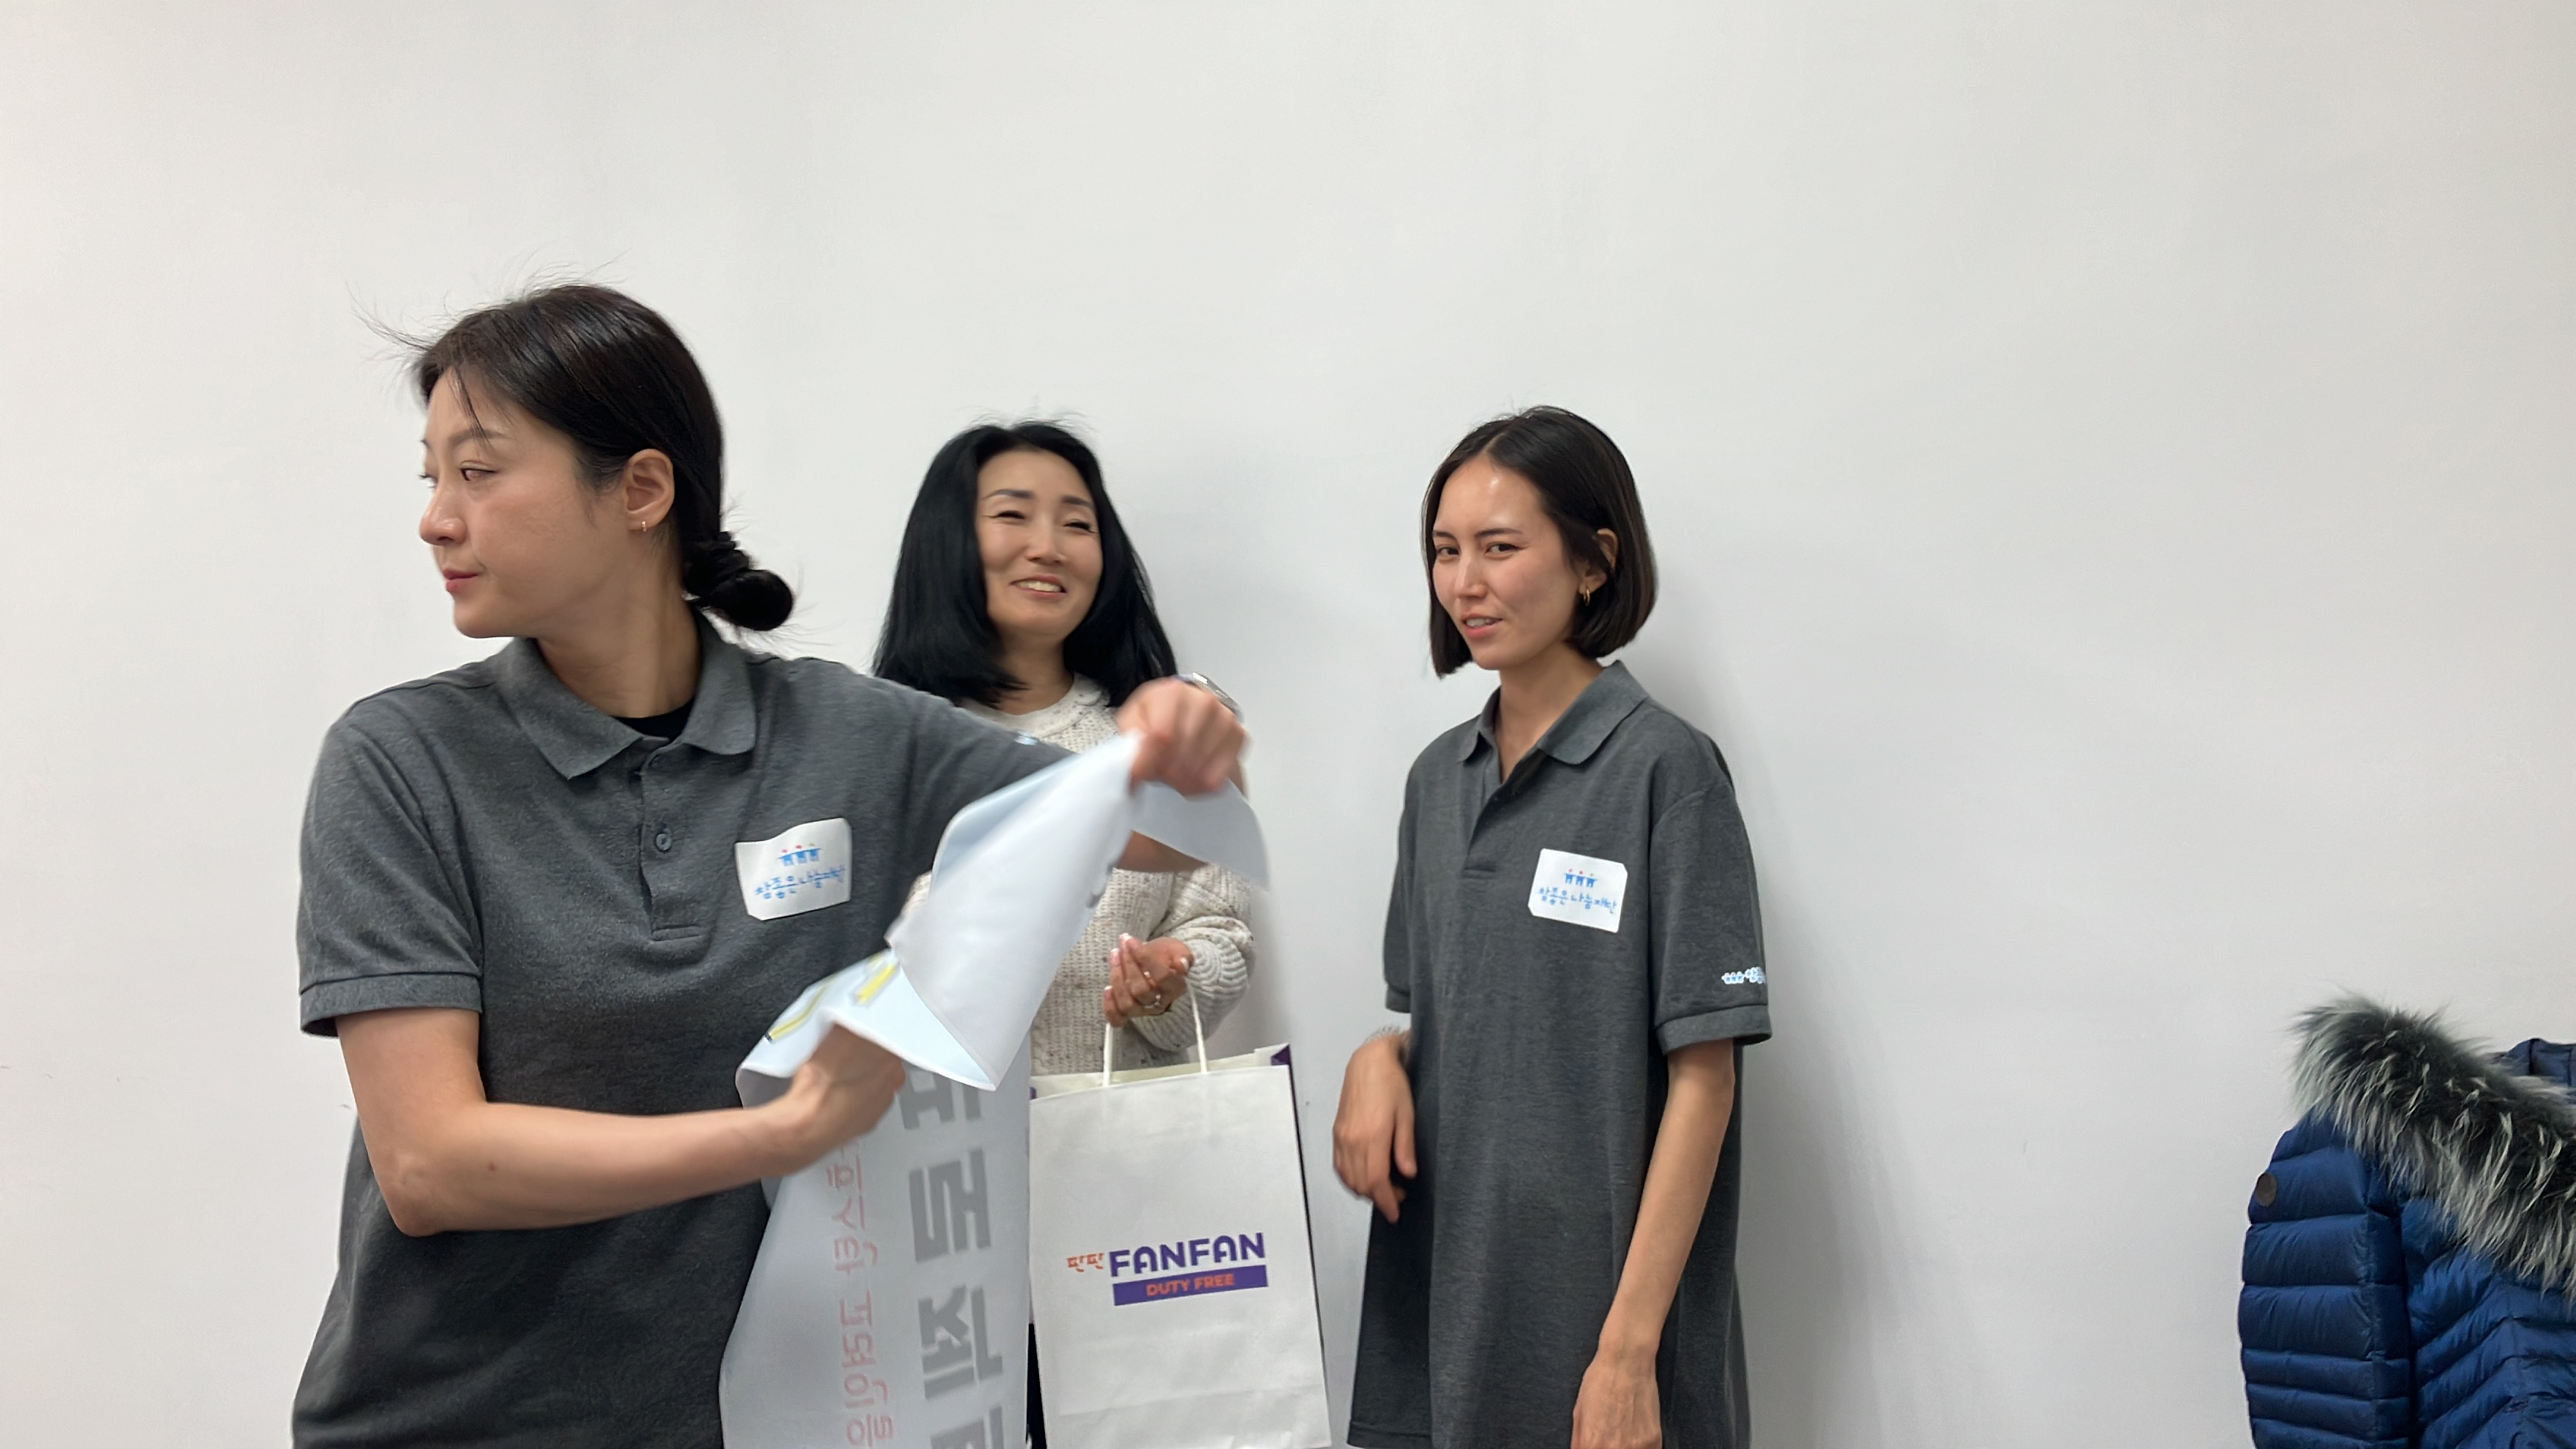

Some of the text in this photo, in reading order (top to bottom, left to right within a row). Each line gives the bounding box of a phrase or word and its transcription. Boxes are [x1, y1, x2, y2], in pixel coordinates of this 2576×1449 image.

[1109, 1232, 1266, 1277] FANFAN
[1145, 1273, 1235, 1297] DUTY FREE
